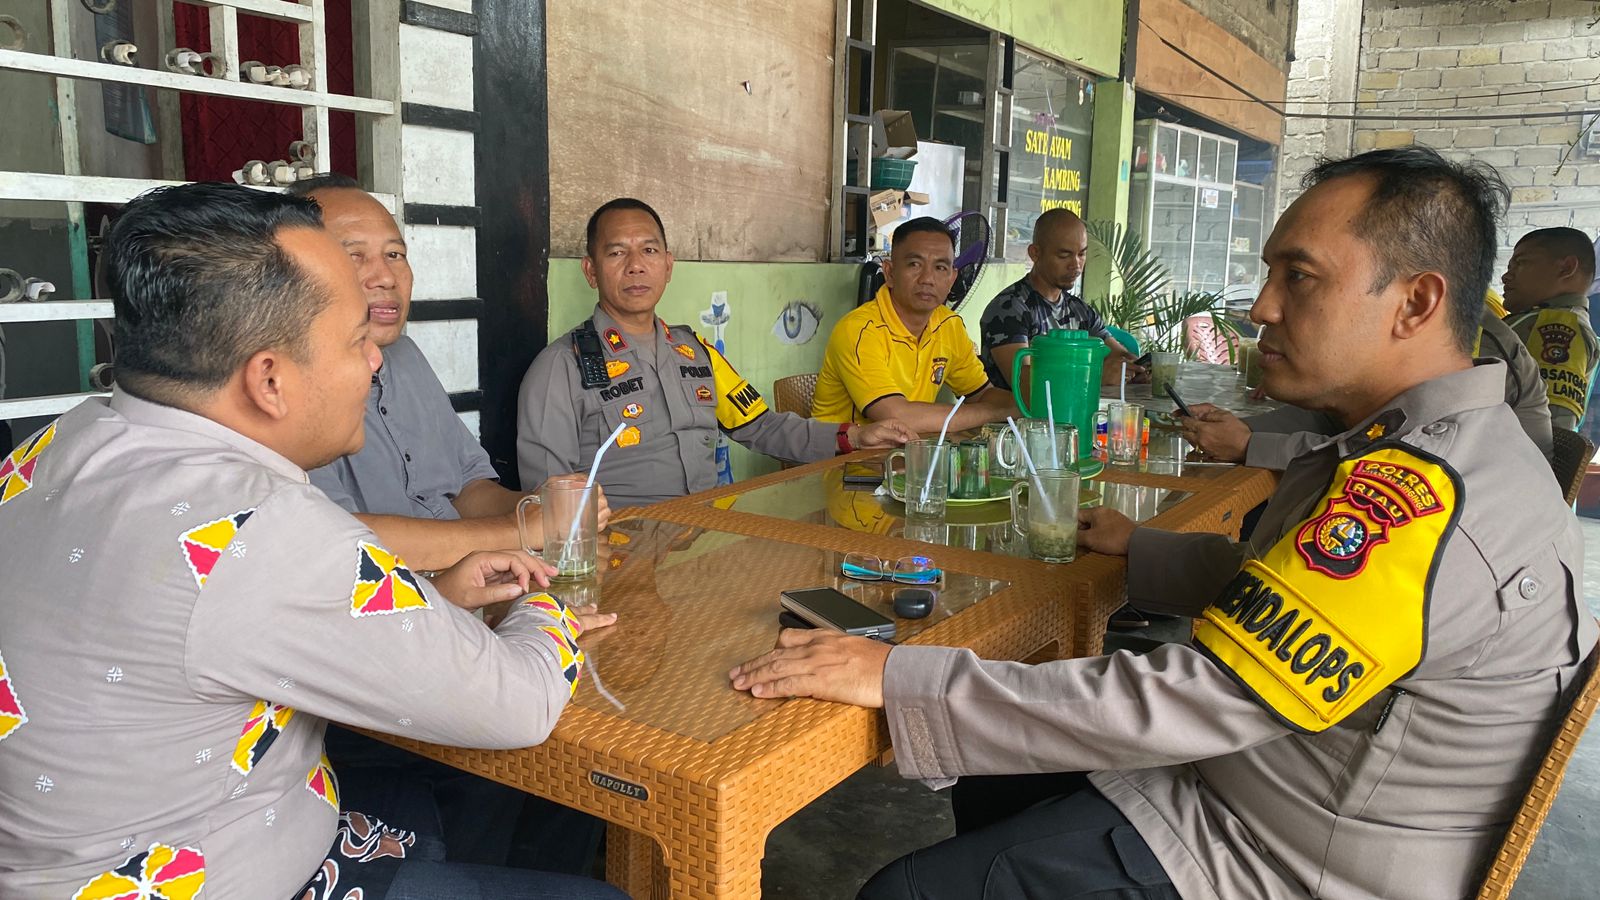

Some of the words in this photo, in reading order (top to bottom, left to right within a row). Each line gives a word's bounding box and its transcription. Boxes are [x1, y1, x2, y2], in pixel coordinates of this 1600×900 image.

[1025, 129, 1048, 155] SATE
[1049, 136, 1072, 160] AYAM
[1043, 167, 1080, 192] KAMBING
[600, 376, 645, 402] ROBET
[1364, 463, 1436, 508] POLRES
[1352, 483, 1404, 518] RIAU
[592, 773, 641, 797] NAPOLLY
